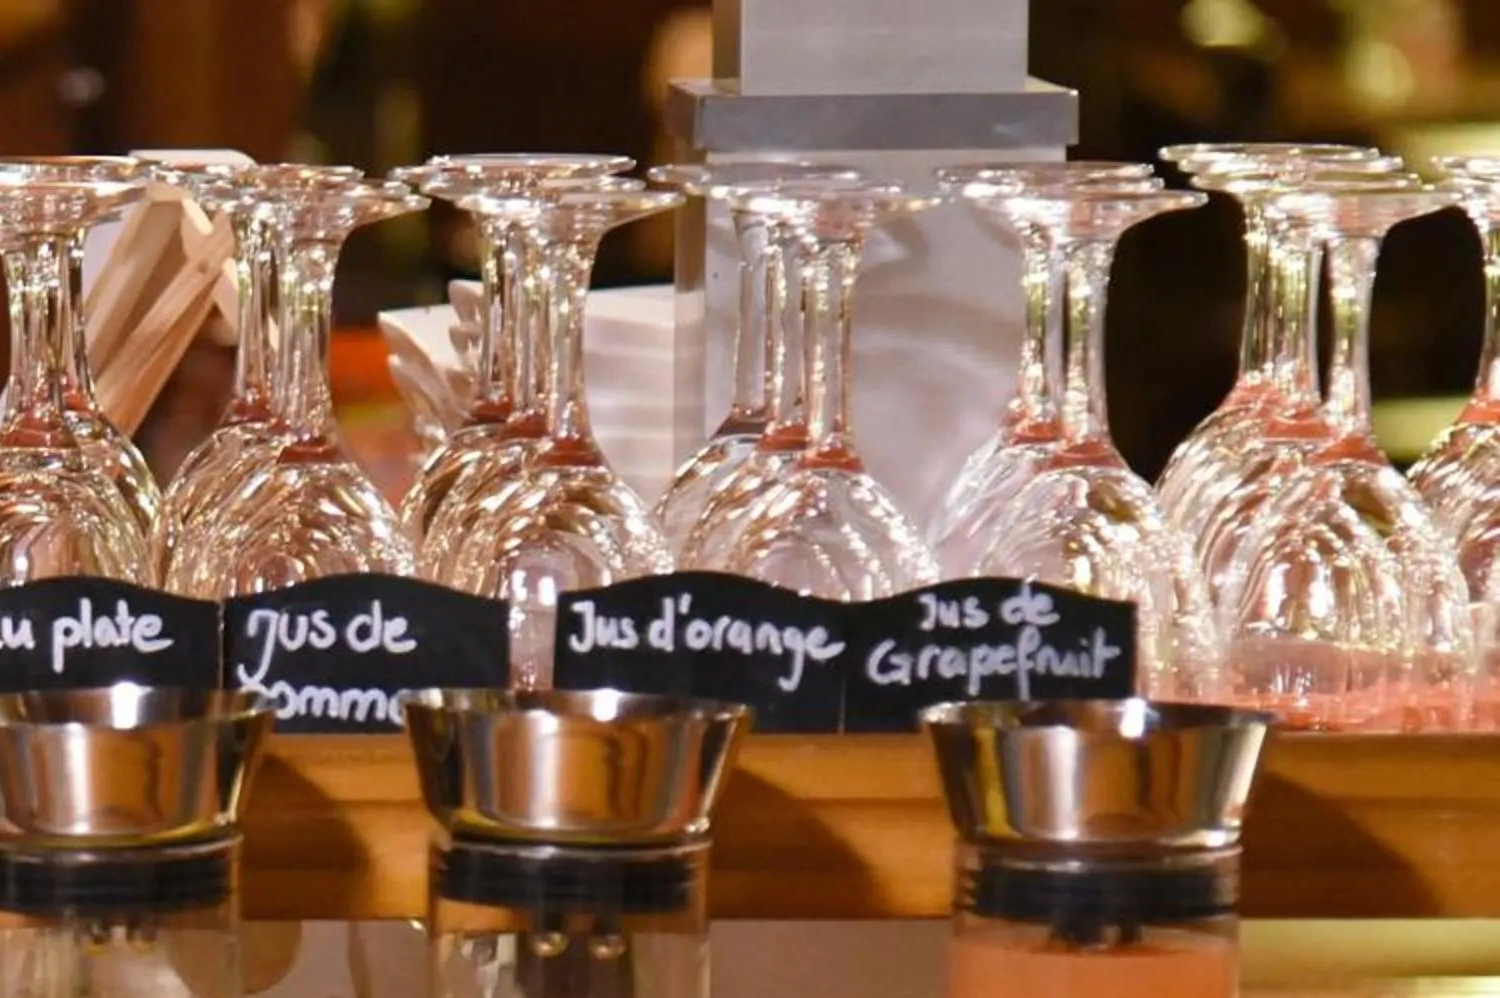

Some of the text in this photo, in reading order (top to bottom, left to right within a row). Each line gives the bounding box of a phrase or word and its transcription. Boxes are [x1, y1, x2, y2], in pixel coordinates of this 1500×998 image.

[51, 598, 174, 673] plate
[345, 599, 418, 653] de
[918, 577, 1060, 631] Jus de
[568, 592, 846, 692] Jus d'orange
[866, 624, 1122, 702] Grapefruit
